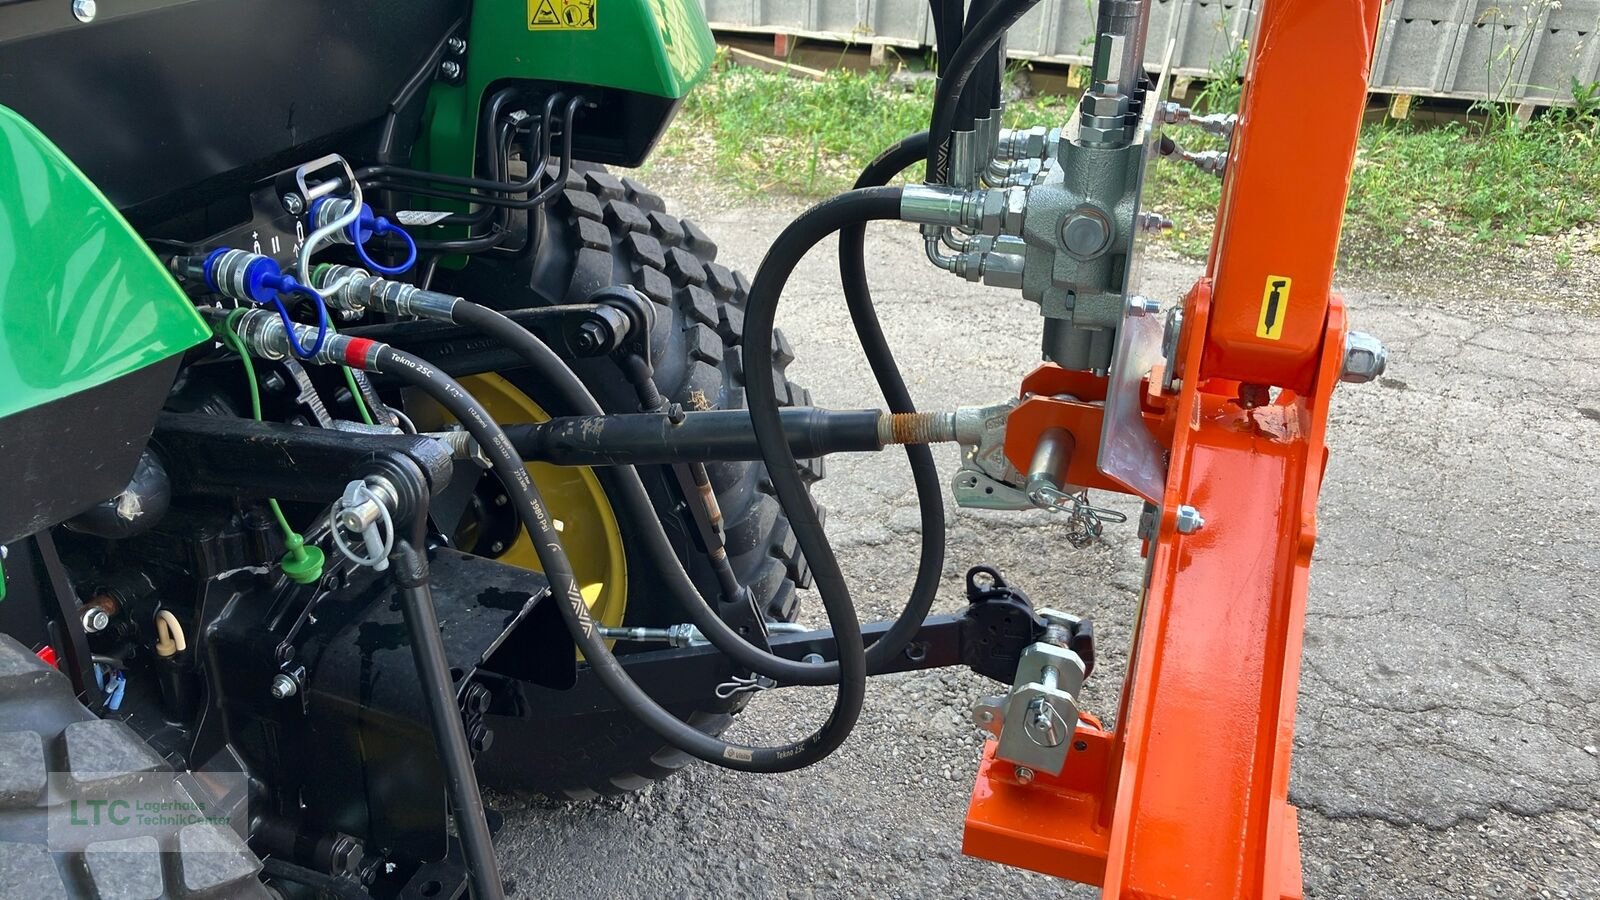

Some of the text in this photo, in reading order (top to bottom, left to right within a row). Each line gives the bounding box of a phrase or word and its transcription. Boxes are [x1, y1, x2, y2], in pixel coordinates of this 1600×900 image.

[391, 352, 416, 368] Tekno
[416, 364, 434, 378] 2SC
[530, 499, 550, 532] 3980 Psi
[776, 750, 794, 759] Tekno
